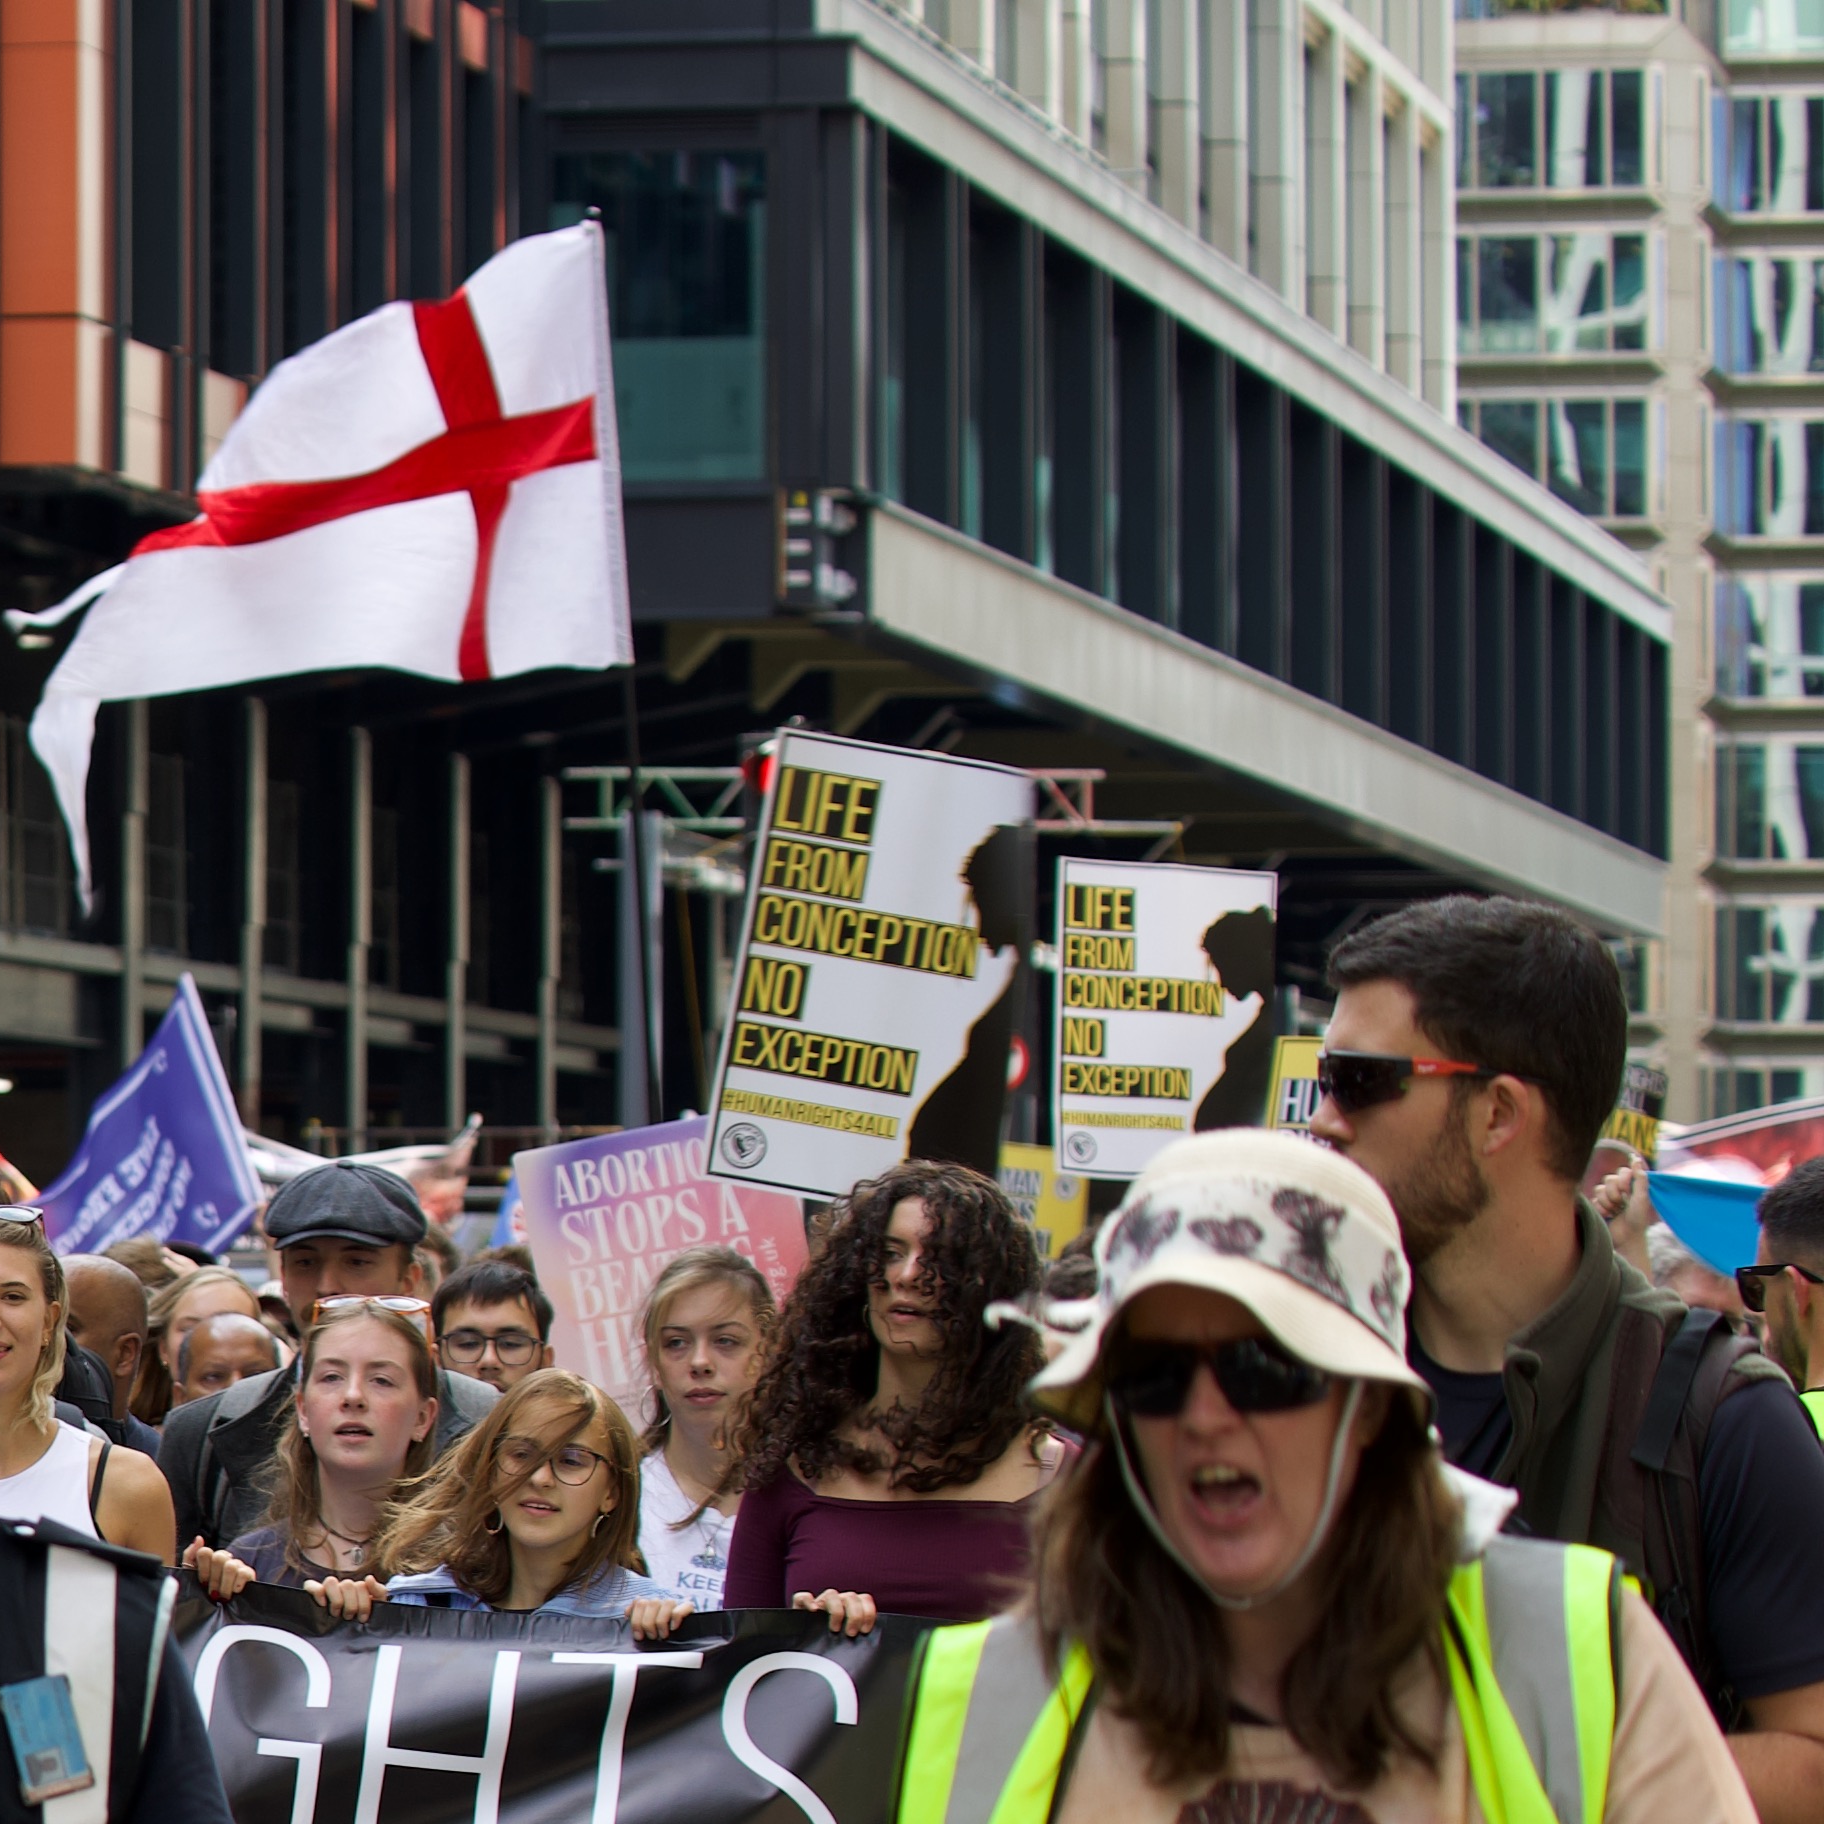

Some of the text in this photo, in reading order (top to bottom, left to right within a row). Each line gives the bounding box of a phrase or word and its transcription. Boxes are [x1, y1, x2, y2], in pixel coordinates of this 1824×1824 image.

[775, 767, 880, 841] LIFE
[763, 840, 869, 901] FROM
[1067, 884, 1133, 930] LIFE
[755, 896, 979, 978] CONCEPTION
[1065, 935, 1134, 970] FROM
[743, 958, 803, 1017] NO
[1065, 974, 1224, 1016] CONCEPTION
[733, 1023, 917, 1094] EXCEPTION
[1064, 1018, 1103, 1056] NO
[1063, 1063, 1190, 1099] EXCEPTION
[722, 1090, 898, 1137] #HUMANRIGHTS4ALL
[1062, 1113, 1185, 1131] #HUMANRIGHTS4ALL
[555, 1137, 708, 1209] ABORTIO
[560, 1182, 751, 1266] STOPS A
[676, 1571, 725, 1595] KEE
